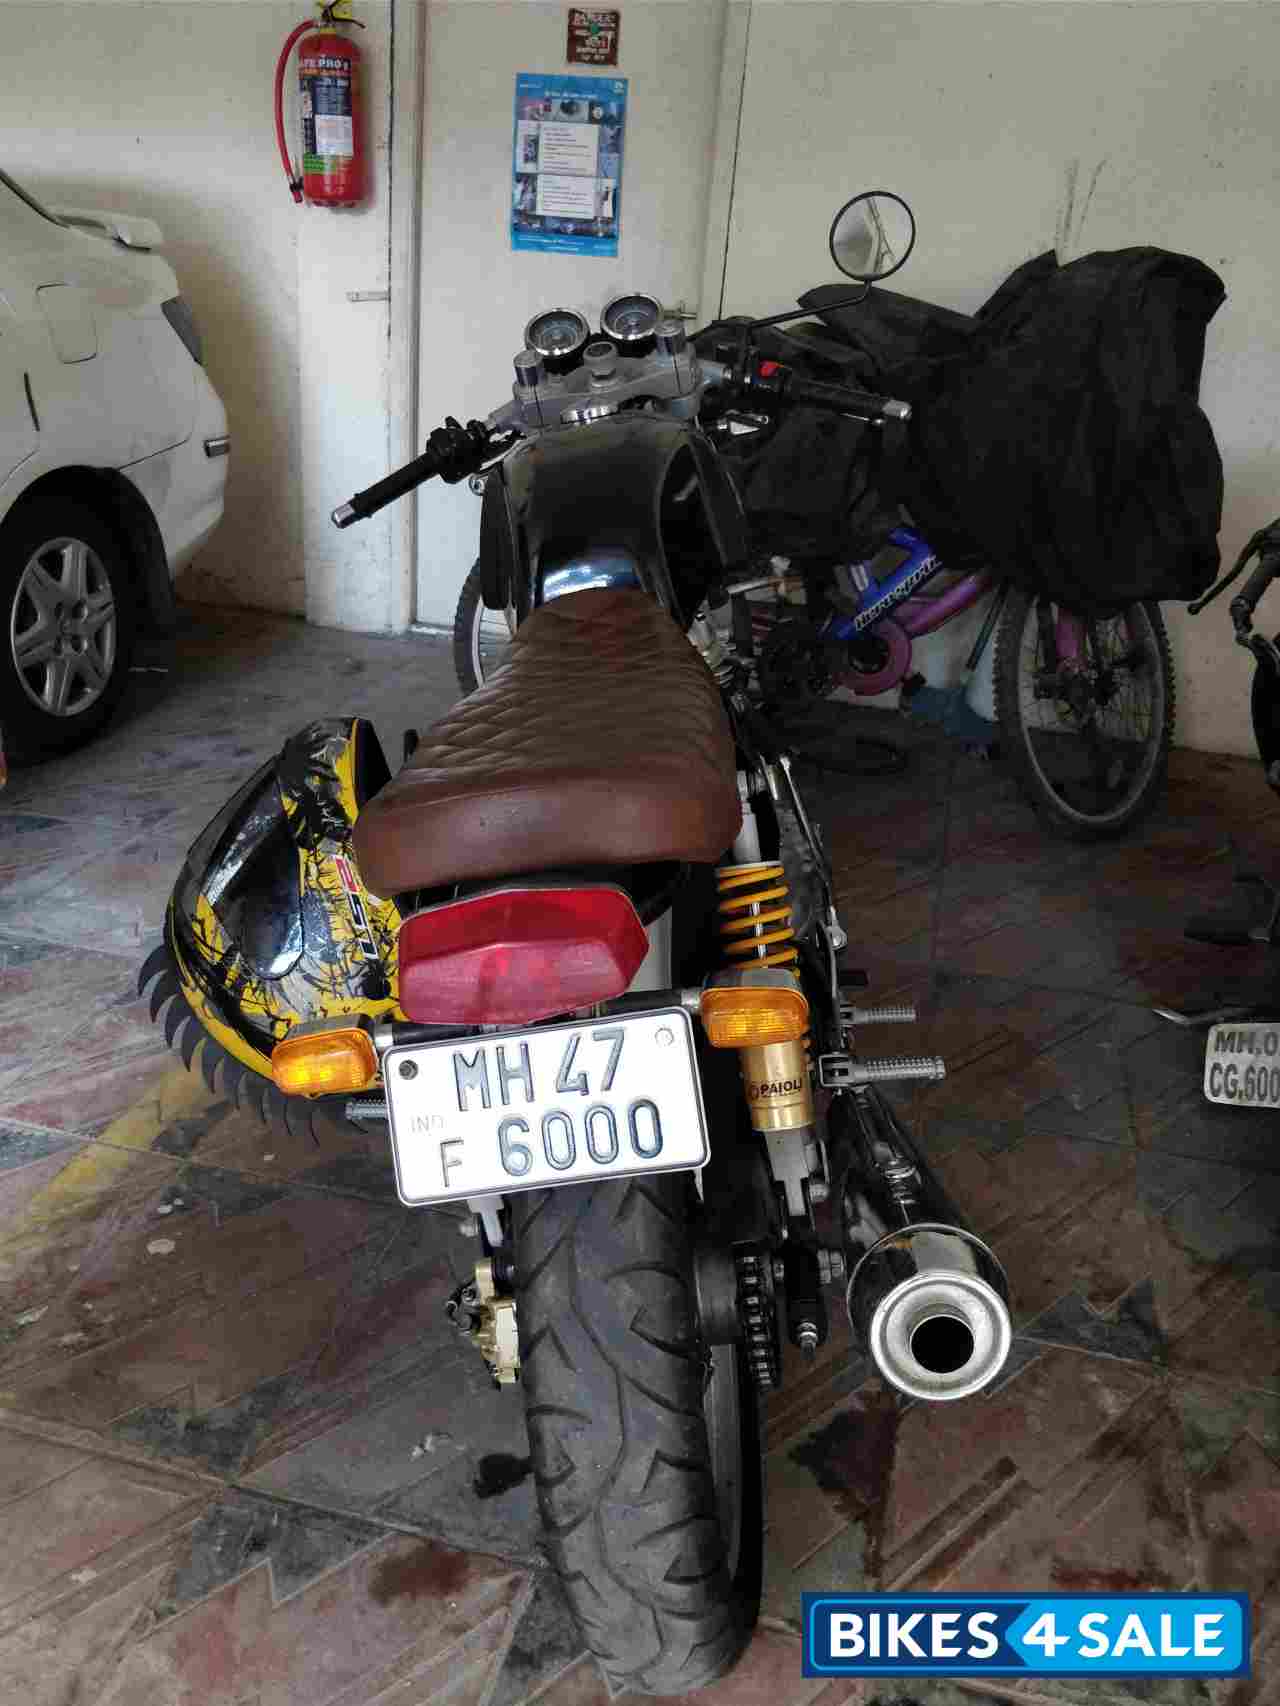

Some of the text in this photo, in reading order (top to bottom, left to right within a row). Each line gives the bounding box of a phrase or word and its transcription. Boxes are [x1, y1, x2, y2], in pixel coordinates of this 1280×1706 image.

[453, 1027, 625, 1112] MH 47
[440, 1098, 663, 1188] F 6000
